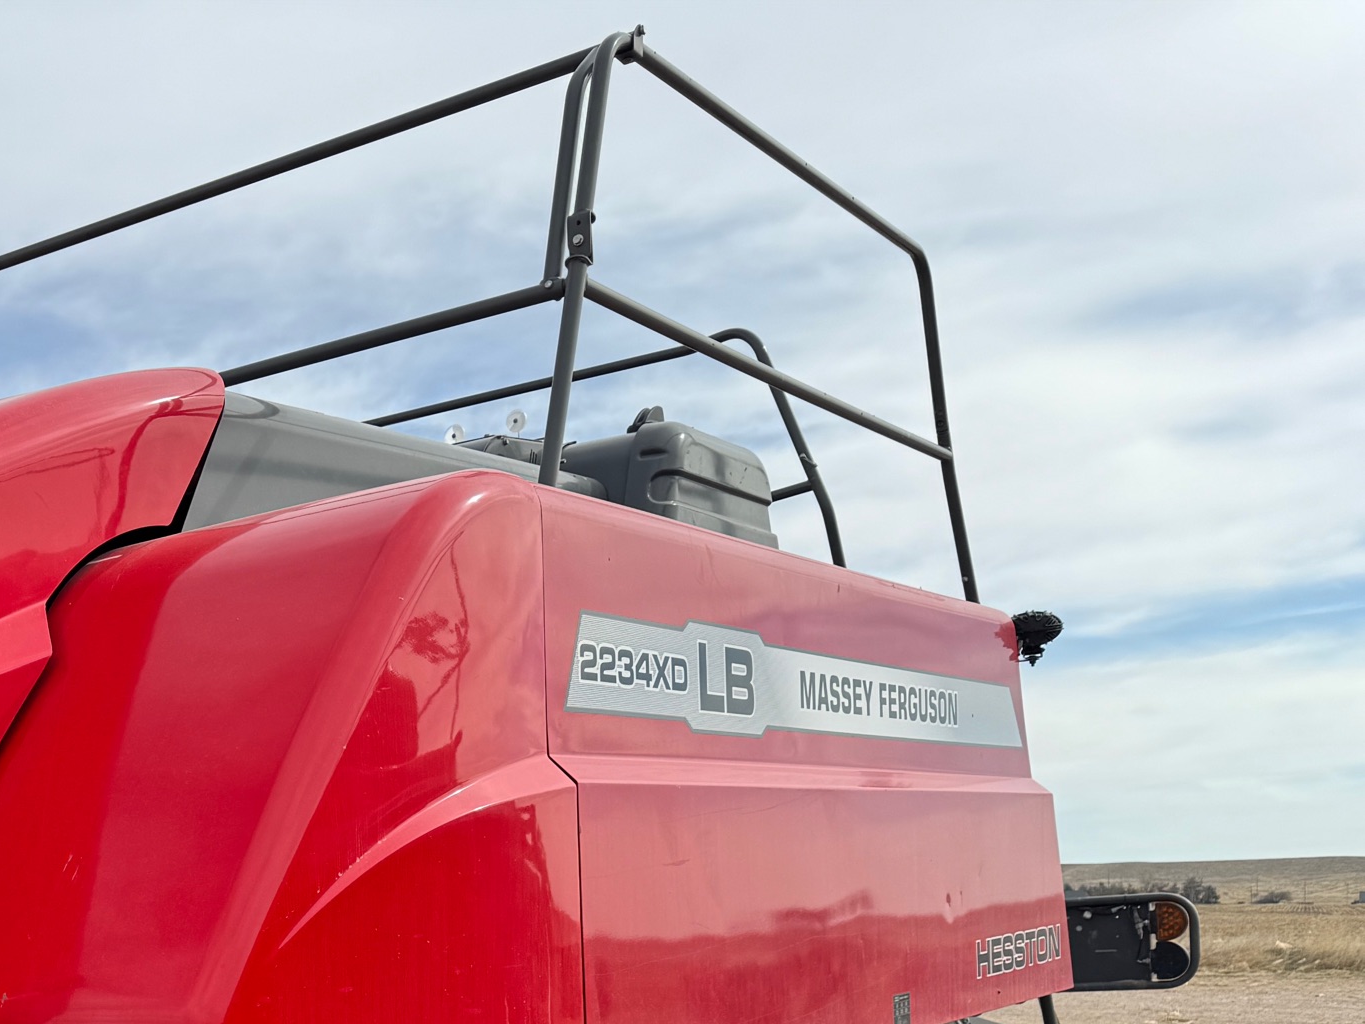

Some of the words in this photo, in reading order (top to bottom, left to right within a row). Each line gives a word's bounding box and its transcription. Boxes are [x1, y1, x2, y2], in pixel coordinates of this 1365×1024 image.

[579, 640, 689, 694] 2234XD
[697, 639, 755, 718] LB
[800, 670, 873, 716] MASSEY
[879, 682, 959, 728] FERGUSON
[976, 923, 1061, 979] HESSTON
